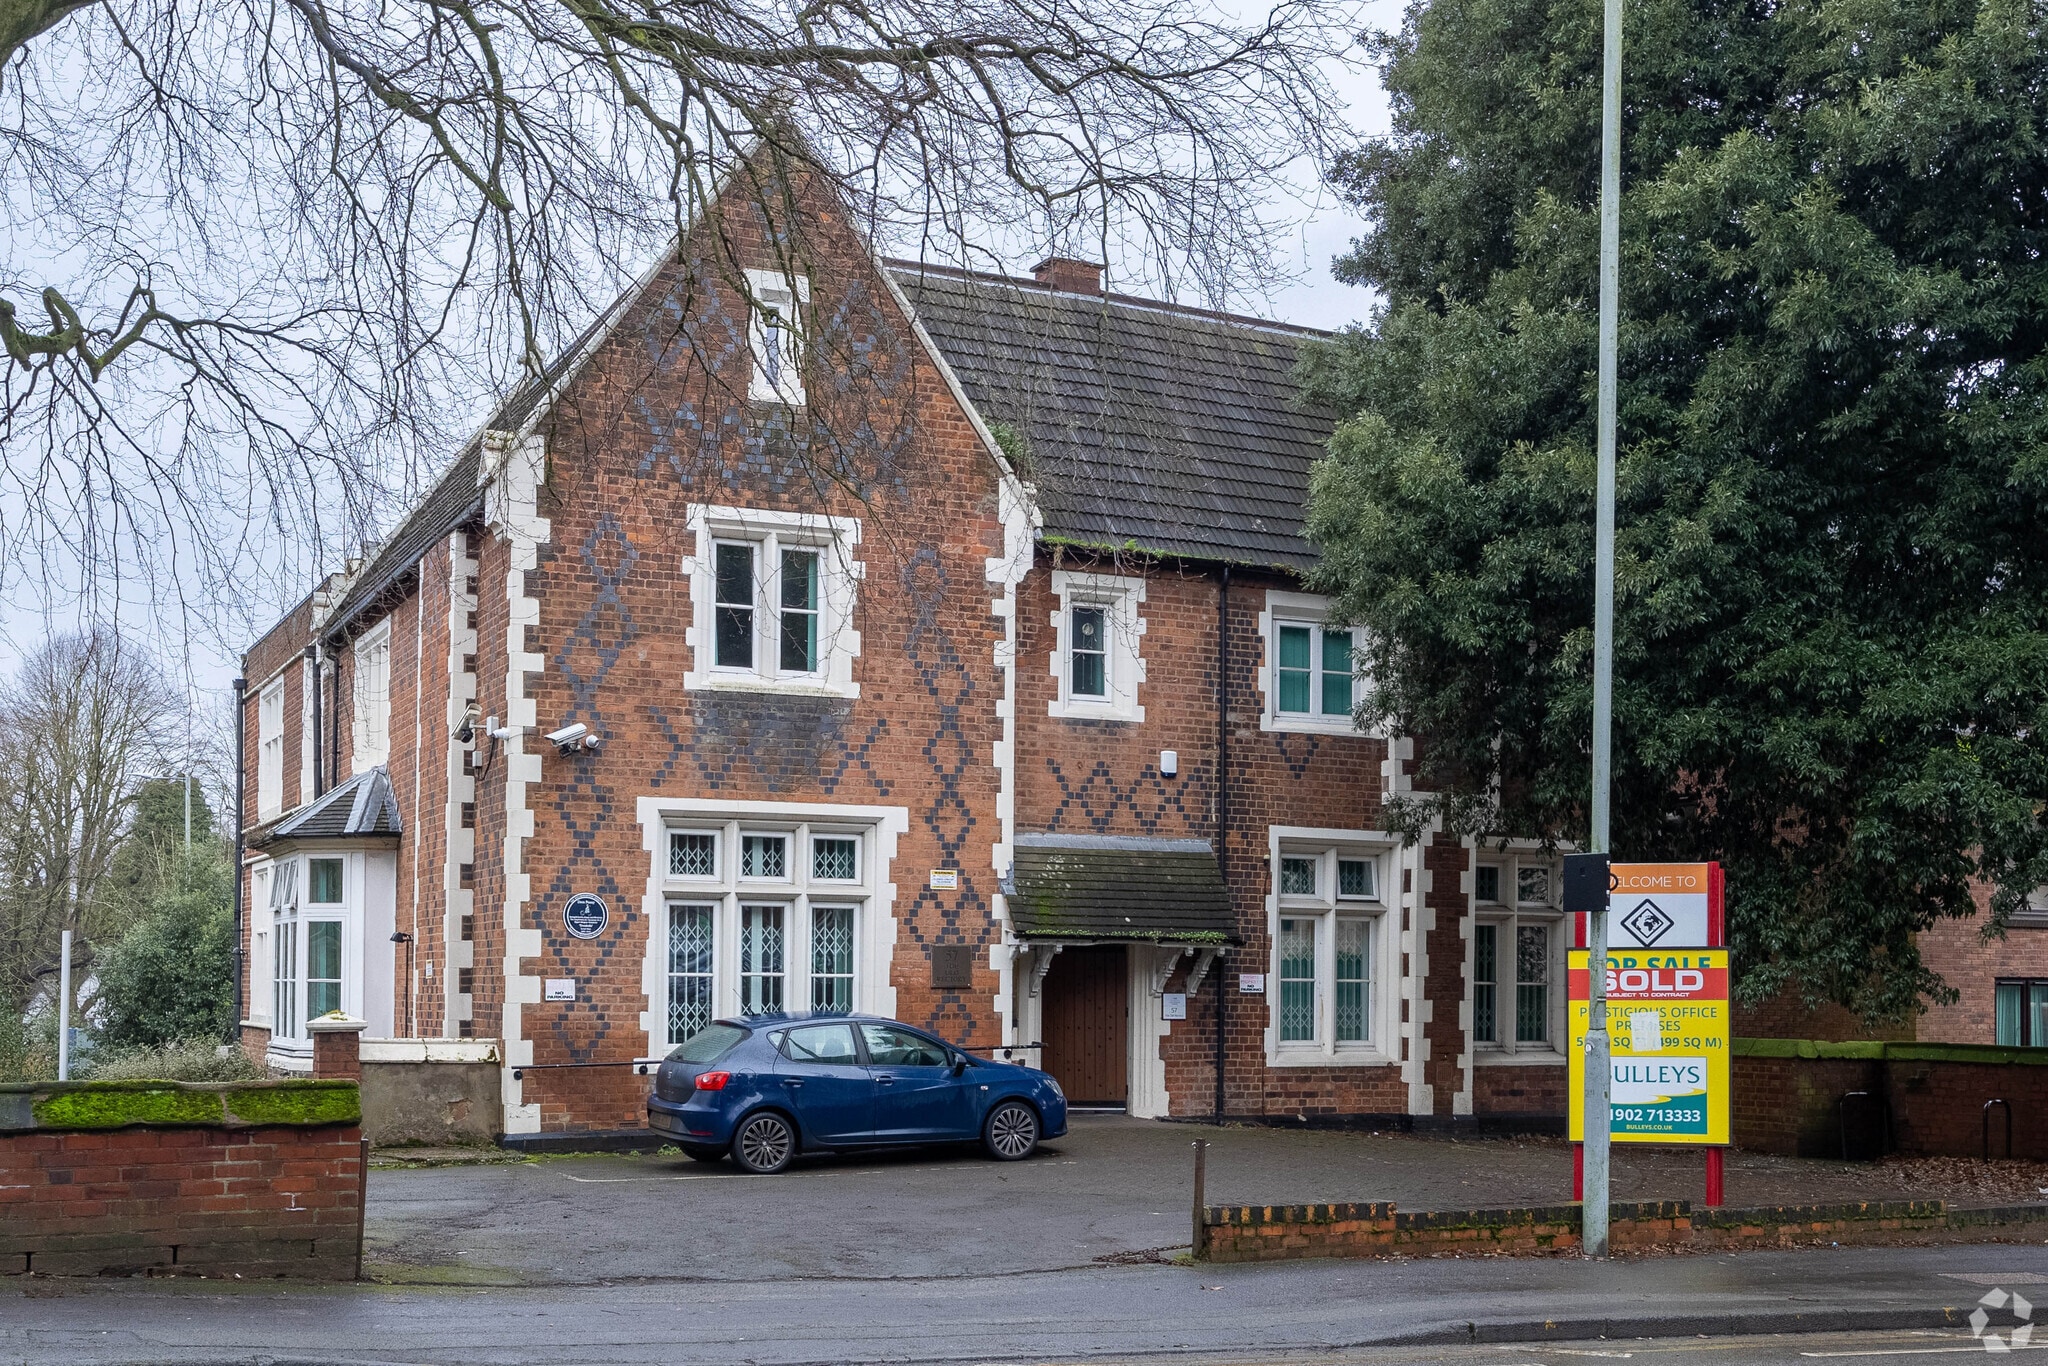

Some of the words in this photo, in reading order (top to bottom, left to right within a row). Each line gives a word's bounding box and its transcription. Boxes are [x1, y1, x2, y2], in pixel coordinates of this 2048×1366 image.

[1676, 876, 1696, 887] TO
[946, 950, 958, 961] 57
[1671, 1007, 1718, 1018] OFFICE
[1616, 1020, 1681, 1031] PRSES
[1613, 1037, 1630, 1048] SQ
[1683, 1037, 1701, 1049] SQ
[1705, 1037, 1722, 1049] M)
[1610, 1065, 1700, 1083] ULLEYS
[1610, 1108, 1643, 1121] 1902
[1646, 1109, 1701, 1122] 713333
